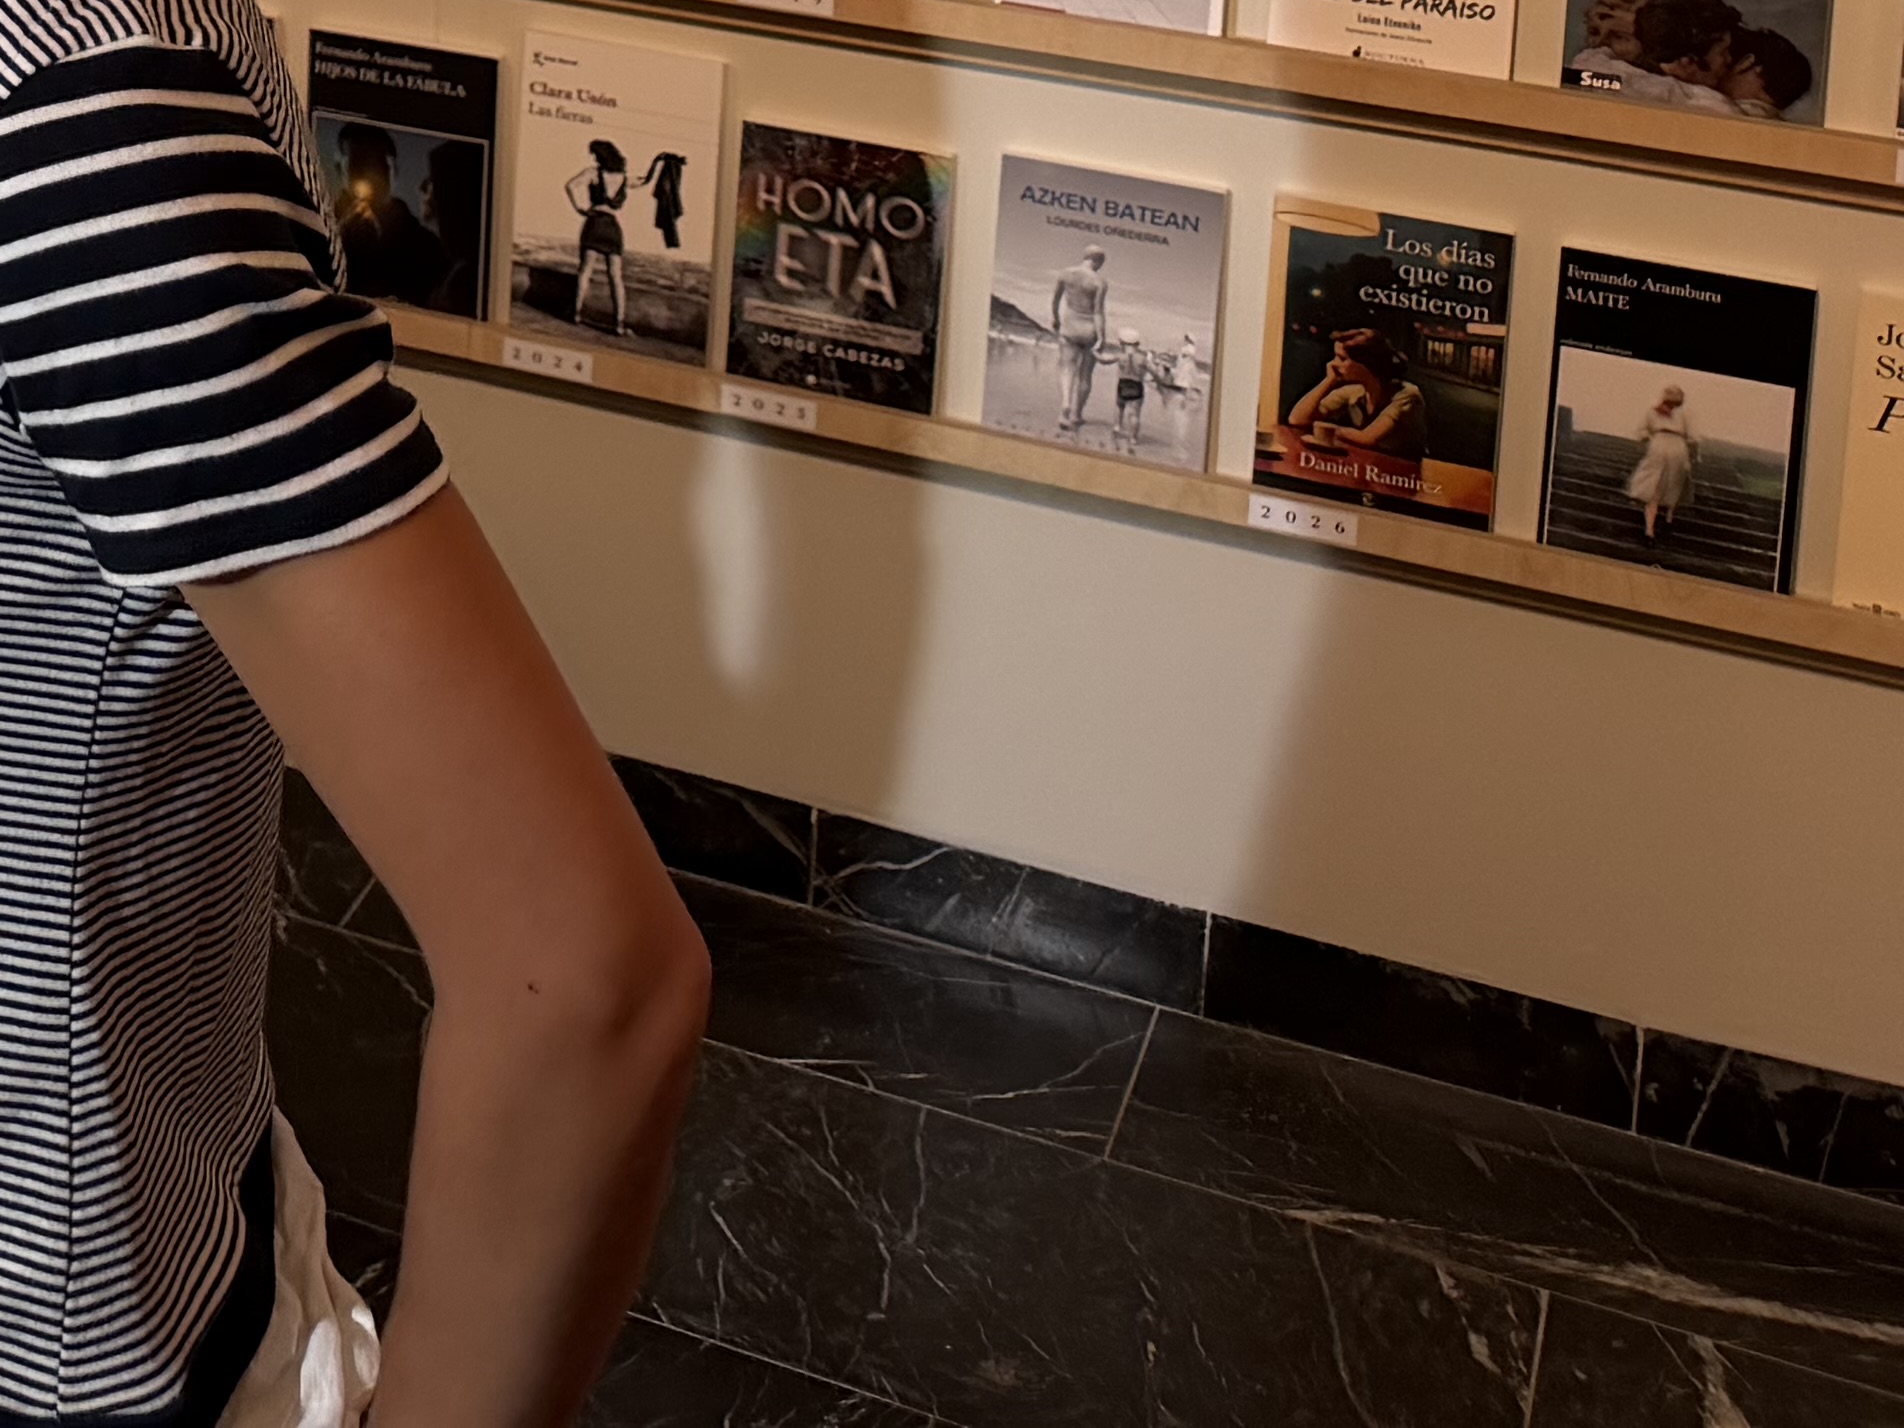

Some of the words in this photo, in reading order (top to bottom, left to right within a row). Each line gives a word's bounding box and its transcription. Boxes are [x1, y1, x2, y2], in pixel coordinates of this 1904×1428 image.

[358, 70, 378, 84] DE
[384, 74, 404, 89] LA
[529, 80, 573, 101] Clara
[1580, 70, 1621, 91] Susa
[756, 171, 929, 240] HOMO
[1020, 184, 1095, 214] AZKEN
[1104, 199, 1201, 233] BATEAN
[774, 224, 897, 310] ETA
[1385, 228, 1433, 258] Los
[1441, 241, 1496, 269] días
[1399, 264, 1449, 291] que
[1458, 275, 1493, 294] no
[1564, 285, 1630, 311] MAITE
[1567, 262, 1637, 289] Fernando
[1641, 277, 1722, 304] Aramburu
[1359, 284, 1490, 322] existieron
[512, 348, 584, 373] 2024
[757, 329, 818, 353] JORGE
[822, 343, 905, 372] CABEZAS
[1300, 450, 1359, 479] Daniel
[1364, 464, 1442, 494] Ramírez
[1260, 505, 1345, 535] 2026
